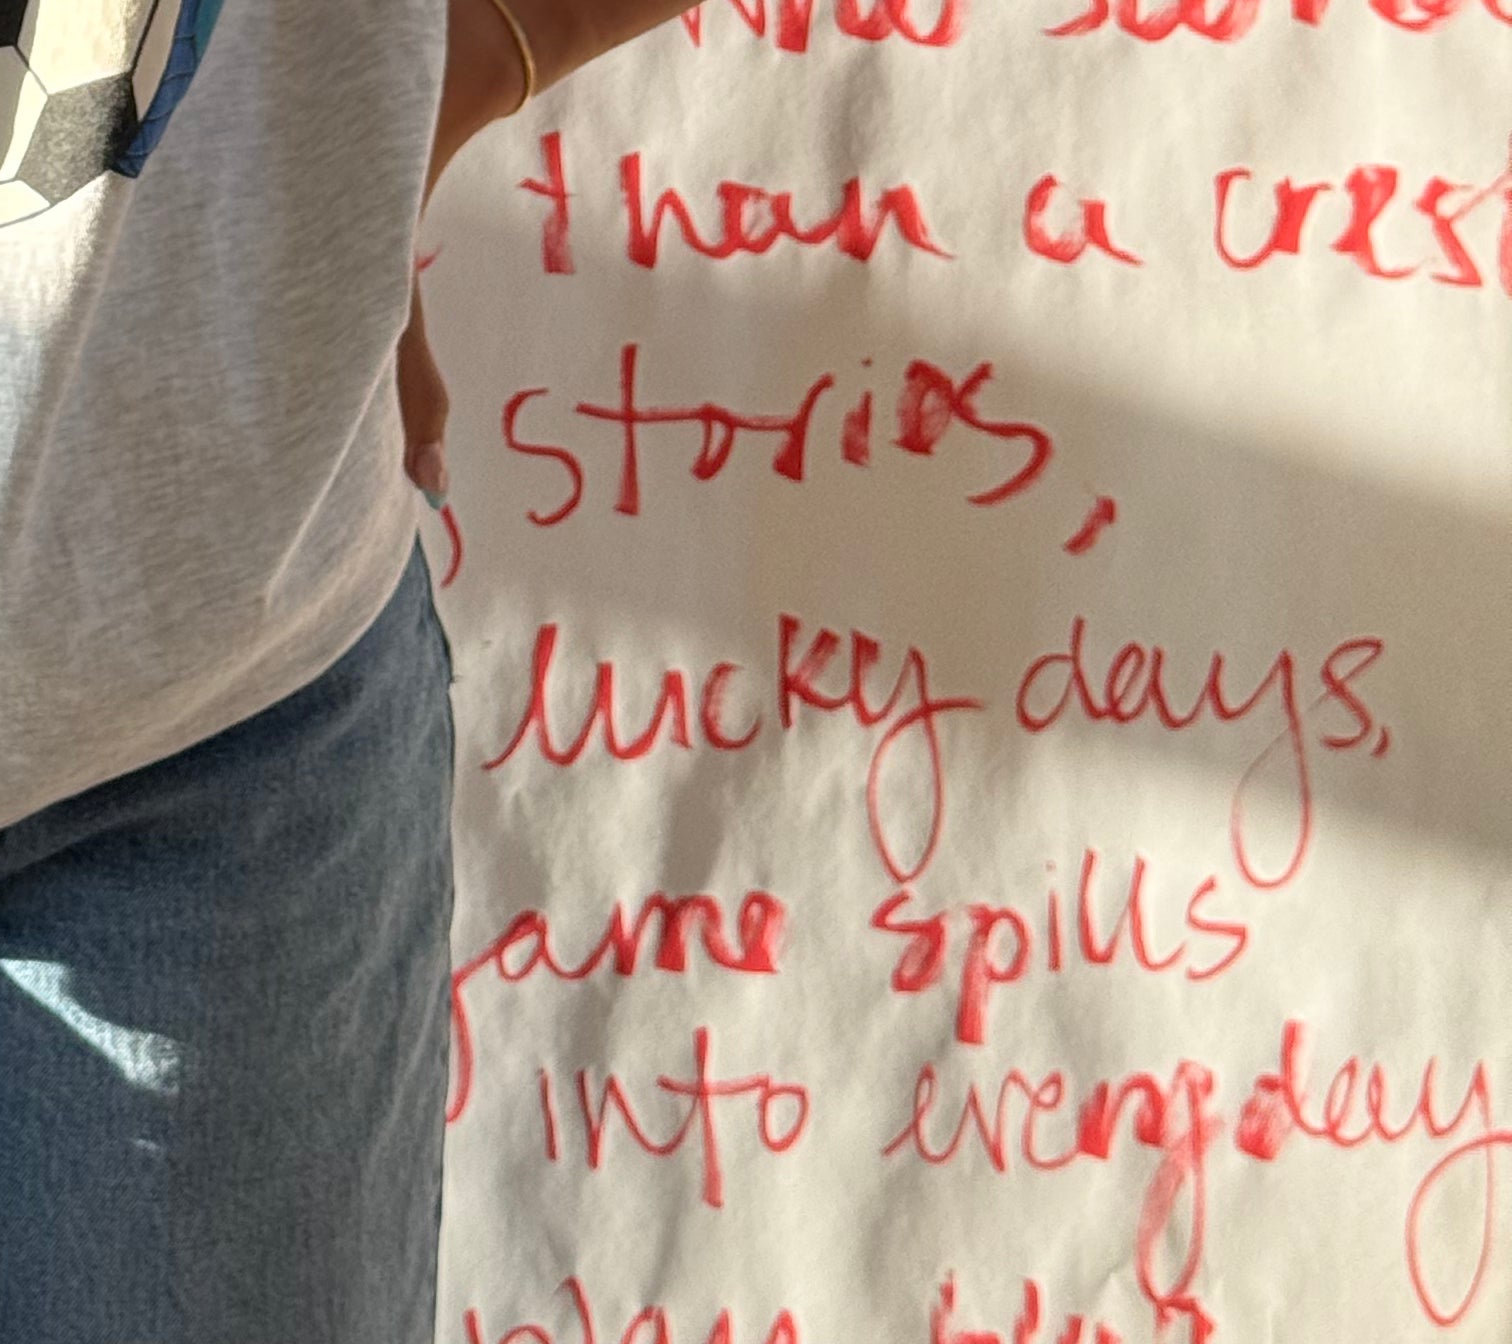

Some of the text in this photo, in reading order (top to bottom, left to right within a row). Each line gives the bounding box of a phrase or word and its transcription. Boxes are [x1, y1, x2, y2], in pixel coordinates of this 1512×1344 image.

[518, 132, 953, 272] than
[1023, 172, 1143, 265] a
[481, 612, 981, 884] lucky
[871, 847, 1248, 1047] spills
[538, 1024, 810, 1207] into
